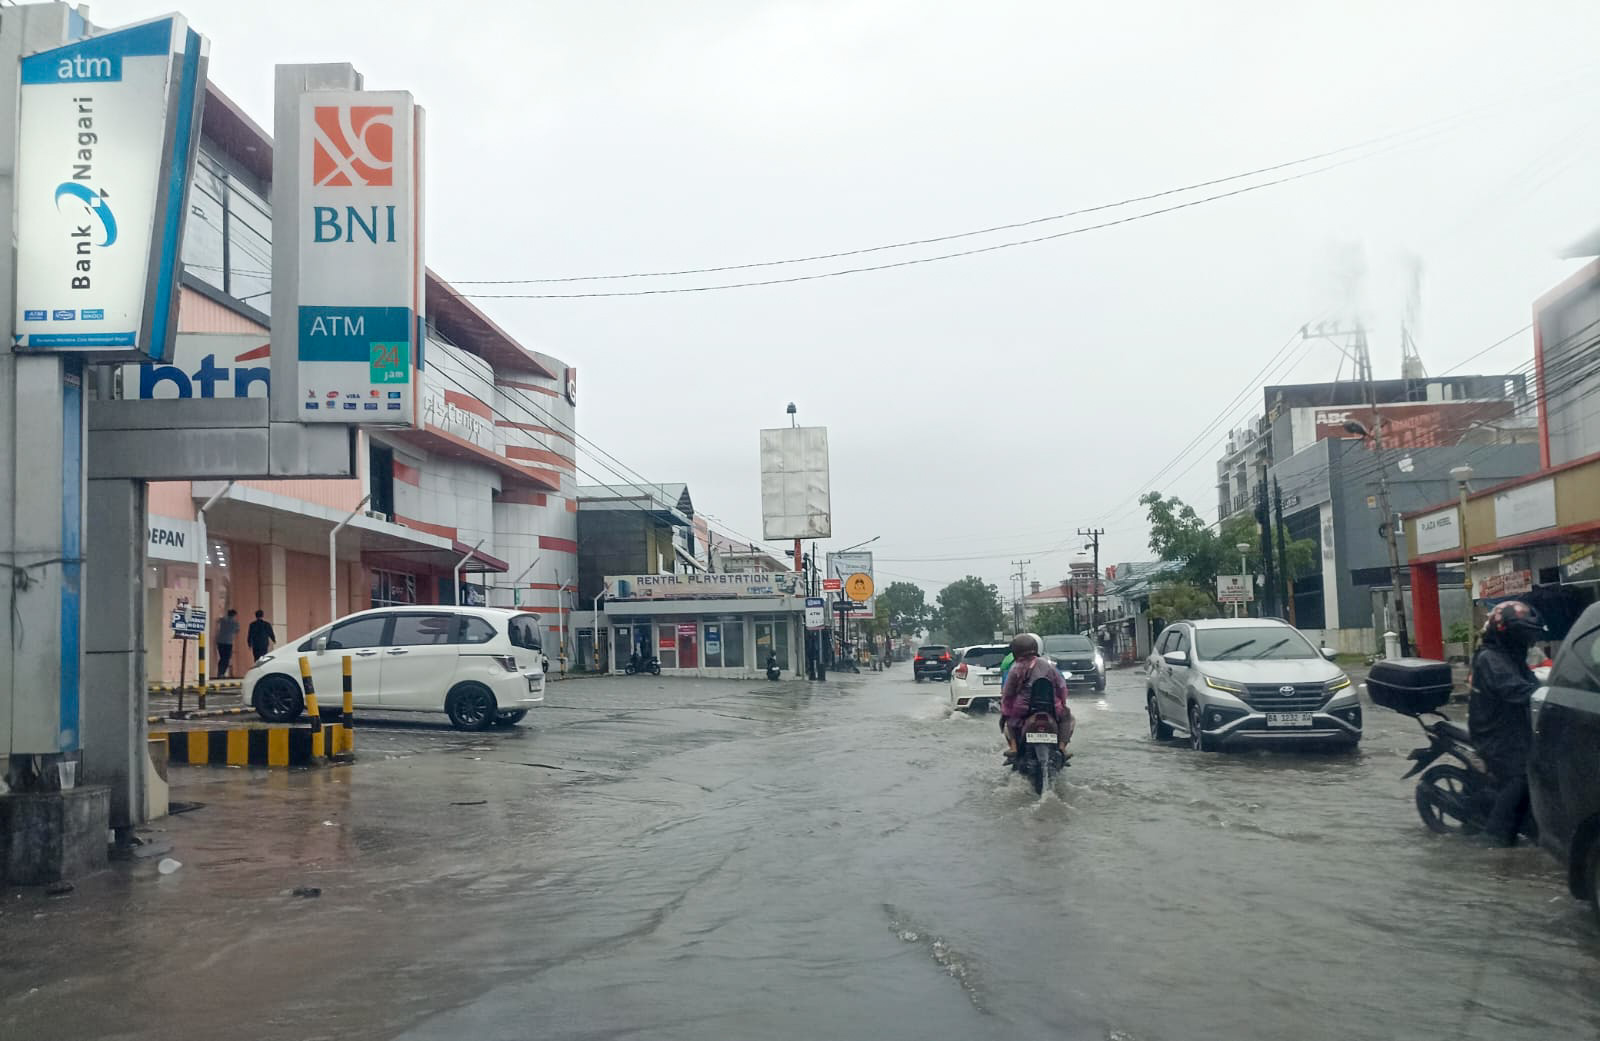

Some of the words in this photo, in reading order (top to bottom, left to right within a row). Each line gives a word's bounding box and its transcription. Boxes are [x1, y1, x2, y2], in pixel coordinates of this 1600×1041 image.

[57, 54, 112, 79] atm
[72, 97, 98, 180] Nagari
[313, 205, 397, 244] BNI
[71, 224, 92, 290] Bank
[310, 315, 365, 337] ATM
[372, 344, 400, 369] 24
[139, 353, 271, 399] btn
[383, 371, 405, 381] jam
[1316, 412, 1352, 424] ABC
[148, 528, 185, 547] EPAN
[636, 576, 683, 586] RENTAL
[687, 574, 770, 585] PLAYSTATION
